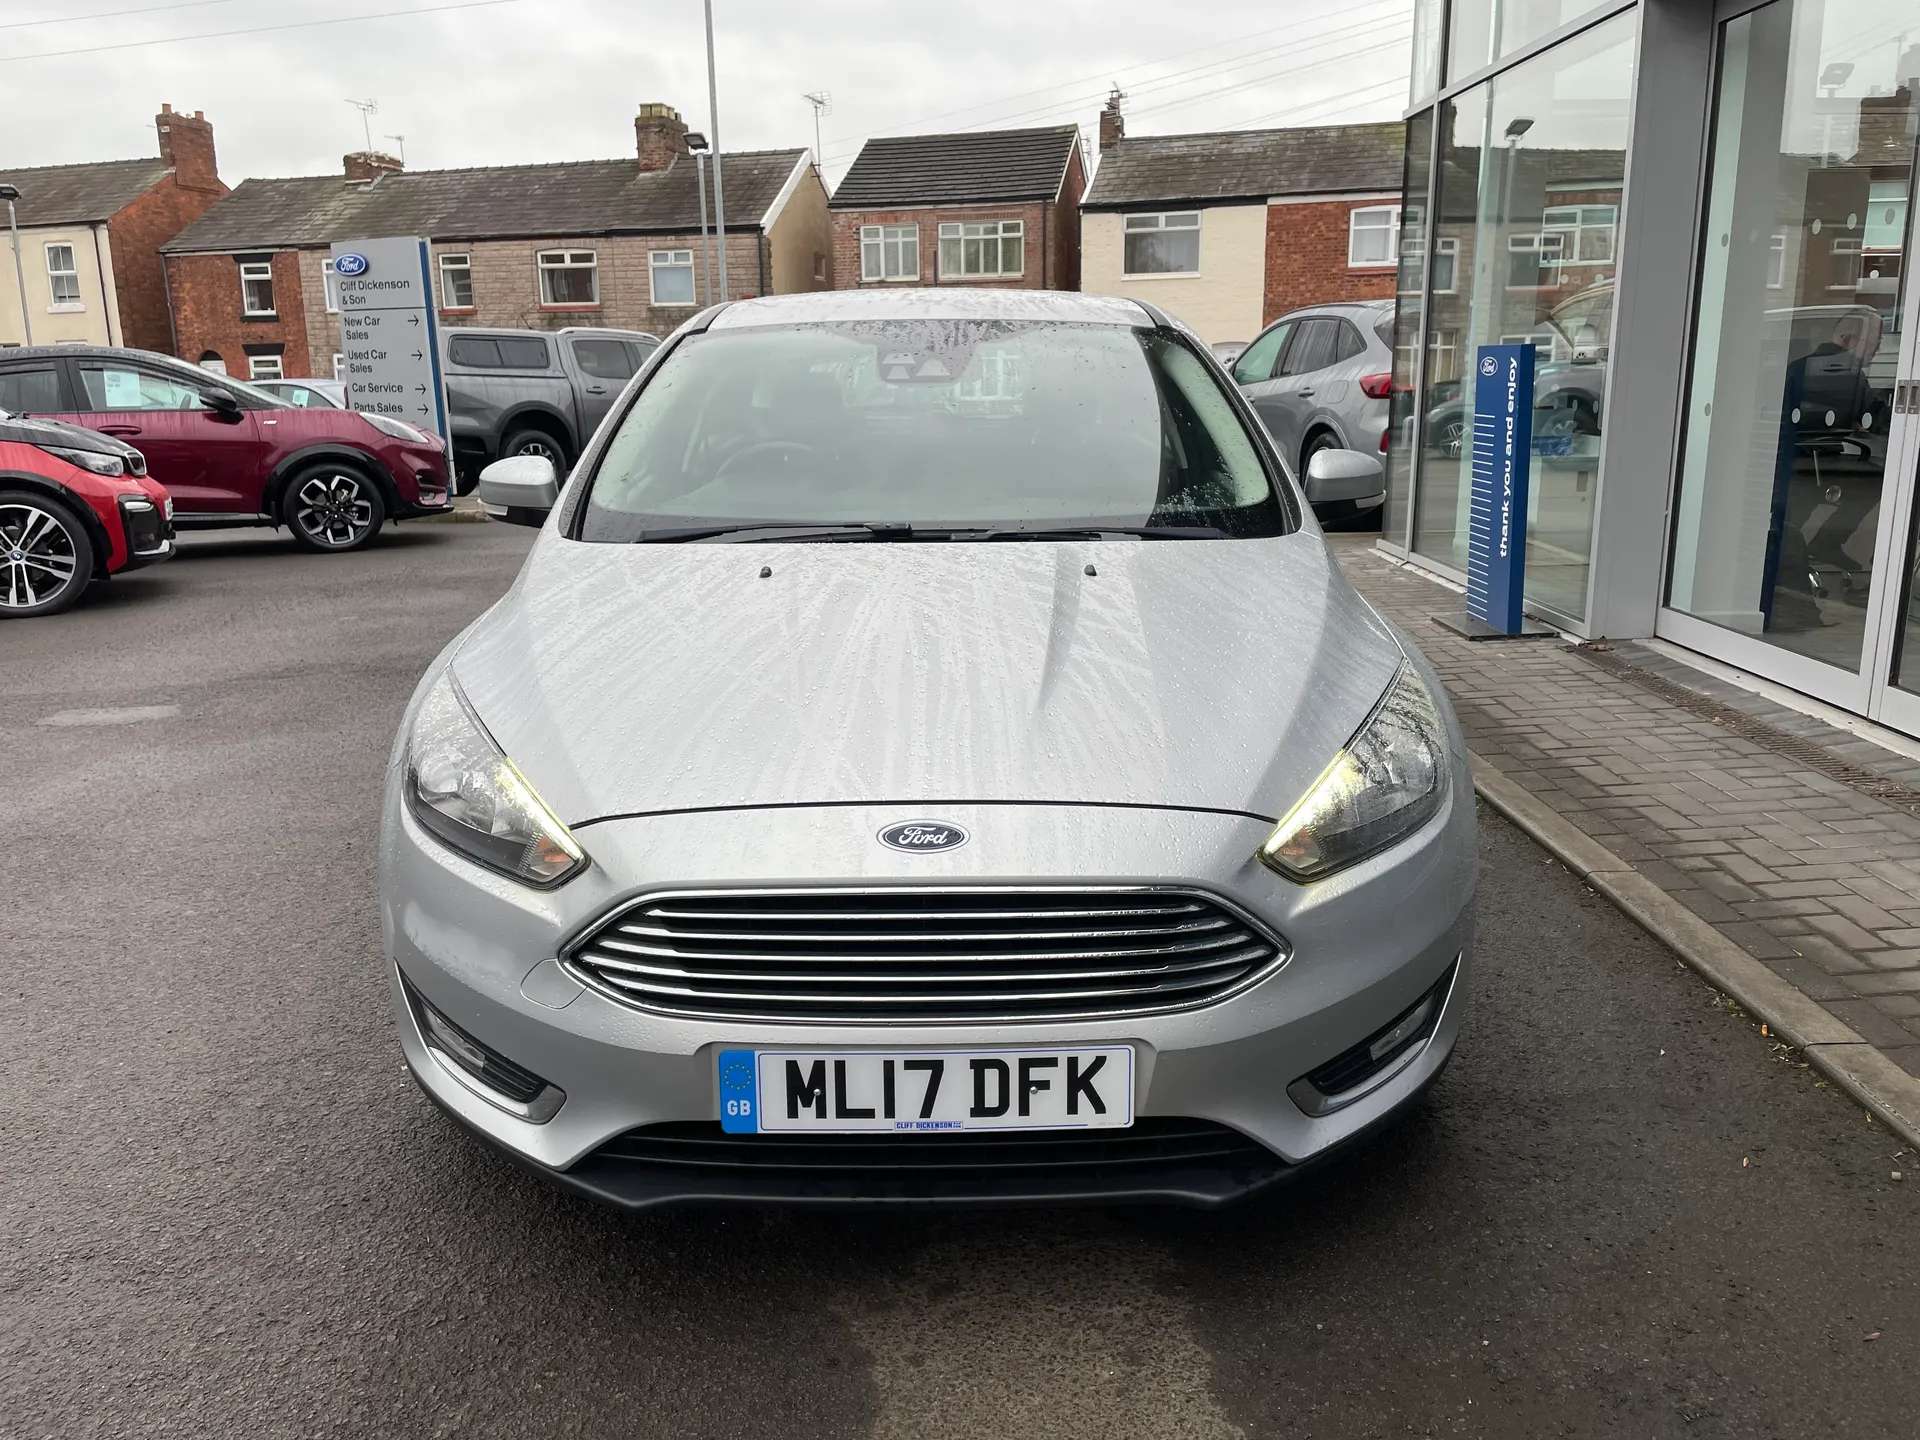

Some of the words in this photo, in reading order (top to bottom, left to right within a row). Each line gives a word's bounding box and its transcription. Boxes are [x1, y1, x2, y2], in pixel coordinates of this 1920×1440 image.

[340, 281, 357, 292] Cliff
[358, 279, 410, 290] Dickenson
[342, 295, 348, 305] &
[349, 295, 366, 305] Son
[344, 316, 362, 327] New
[364, 316, 380, 326] Car
[346, 330, 369, 340] Sales
[348, 350, 369, 360] Used
[371, 350, 387, 360] Car
[349, 364, 373, 373] Sales
[352, 383, 366, 393] Car
[368, 383, 403, 393] Service
[1507, 356, 1518, 413] enjoy
[354, 402, 375, 413] Parts
[377, 402, 403, 413] Sales
[1505, 416, 1514, 457] and
[1500, 500, 1509, 558] thank
[898, 826, 949, 845] Ford
[785, 1058, 945, 1119] ML17
[969, 1055, 1108, 1118] DFK
[727, 1100, 751, 1117] GB
[896, 1121, 913, 1129] CLIFF
[916, 1121, 952, 1129] DICKENSON
